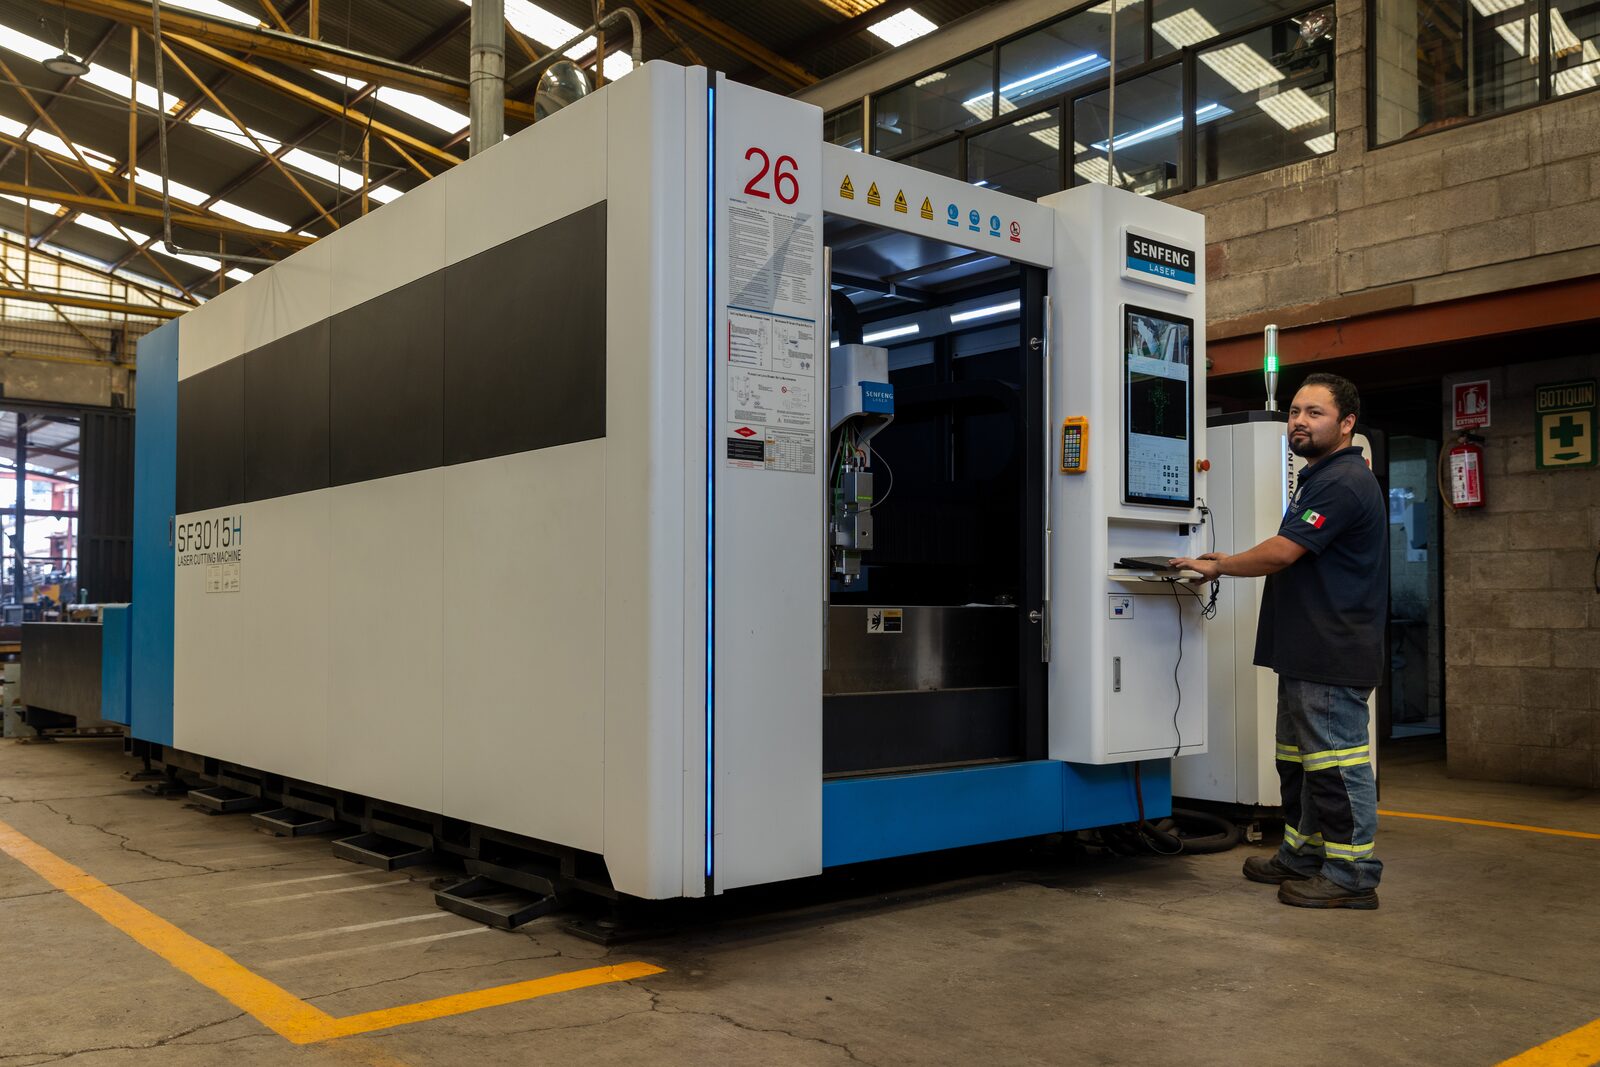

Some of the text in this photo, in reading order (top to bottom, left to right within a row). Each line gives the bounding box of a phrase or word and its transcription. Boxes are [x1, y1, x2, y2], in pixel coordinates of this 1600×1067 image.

[744, 147, 799, 204] 26
[1133, 240, 1190, 267] SENFENG
[1149, 264, 1176, 277] LASER
[865, 391, 894, 399] SENFENG
[1540, 386, 1593, 408] BOTIQUIN
[1456, 416, 1486, 426] EXTINTOR
[178, 515, 242, 552] SF3015H
[178, 549, 241, 567] LASER CUTTING MACHINE
